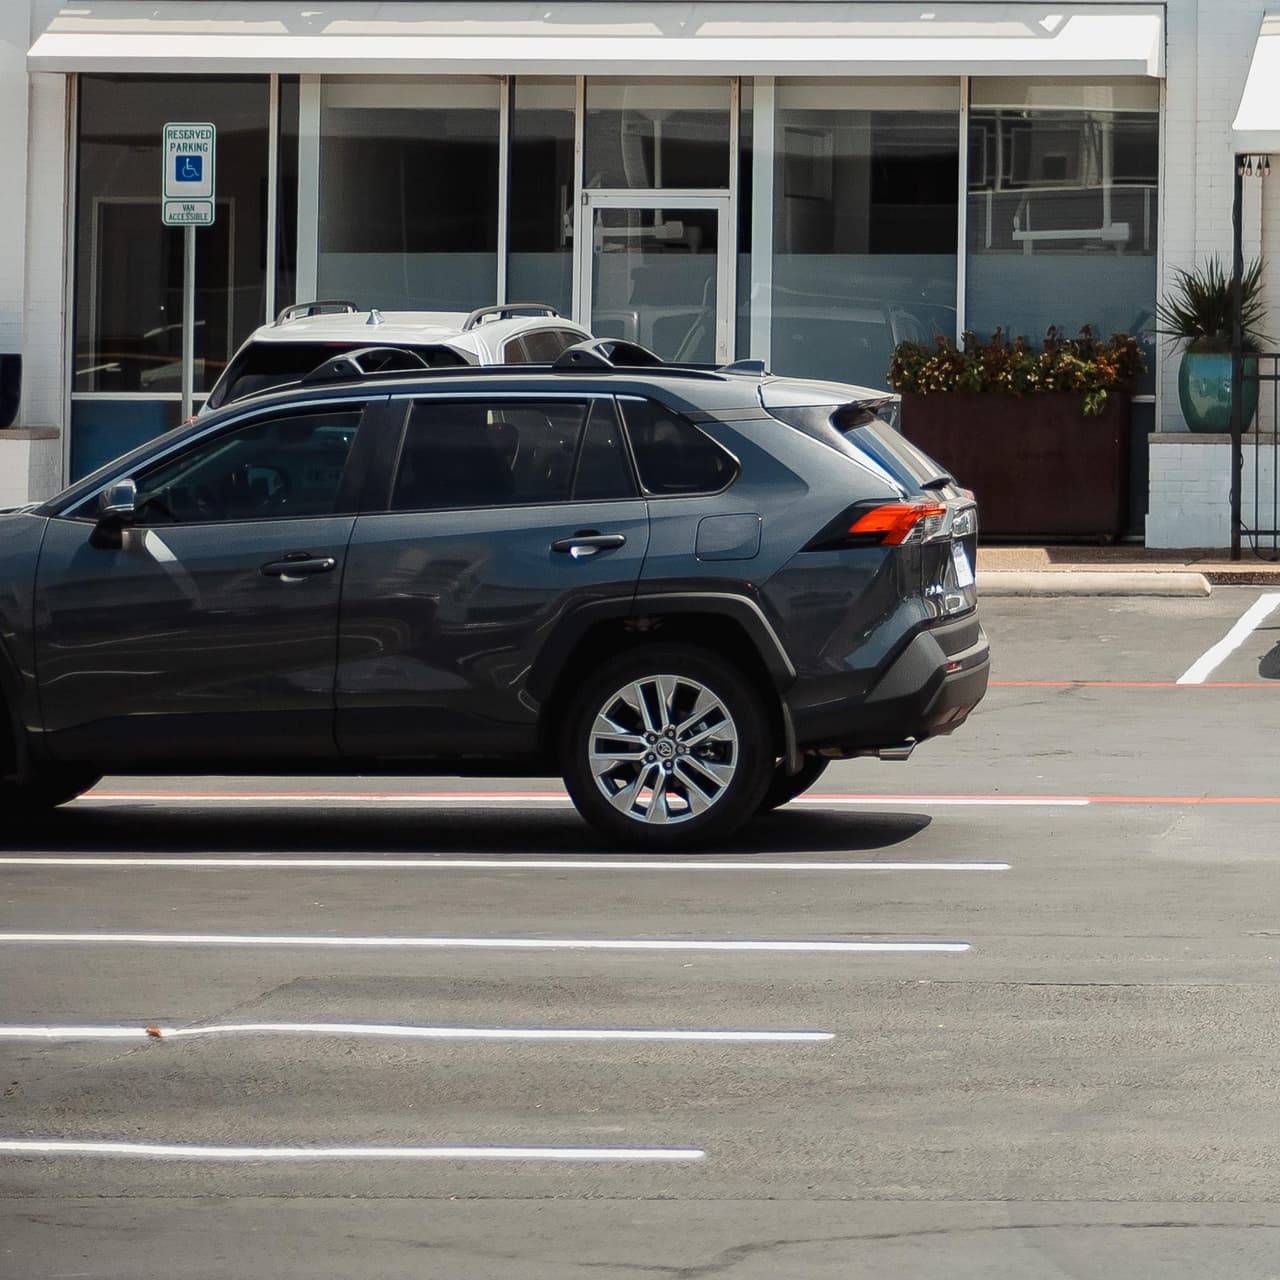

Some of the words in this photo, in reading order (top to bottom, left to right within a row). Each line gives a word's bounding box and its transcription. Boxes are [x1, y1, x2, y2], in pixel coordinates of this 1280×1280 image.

[167, 129, 211, 140] RESERVED
[170, 142, 208, 153] PARKING
[183, 204, 195, 212] VAN
[168, 213, 209, 221] ACCESSIBLE
